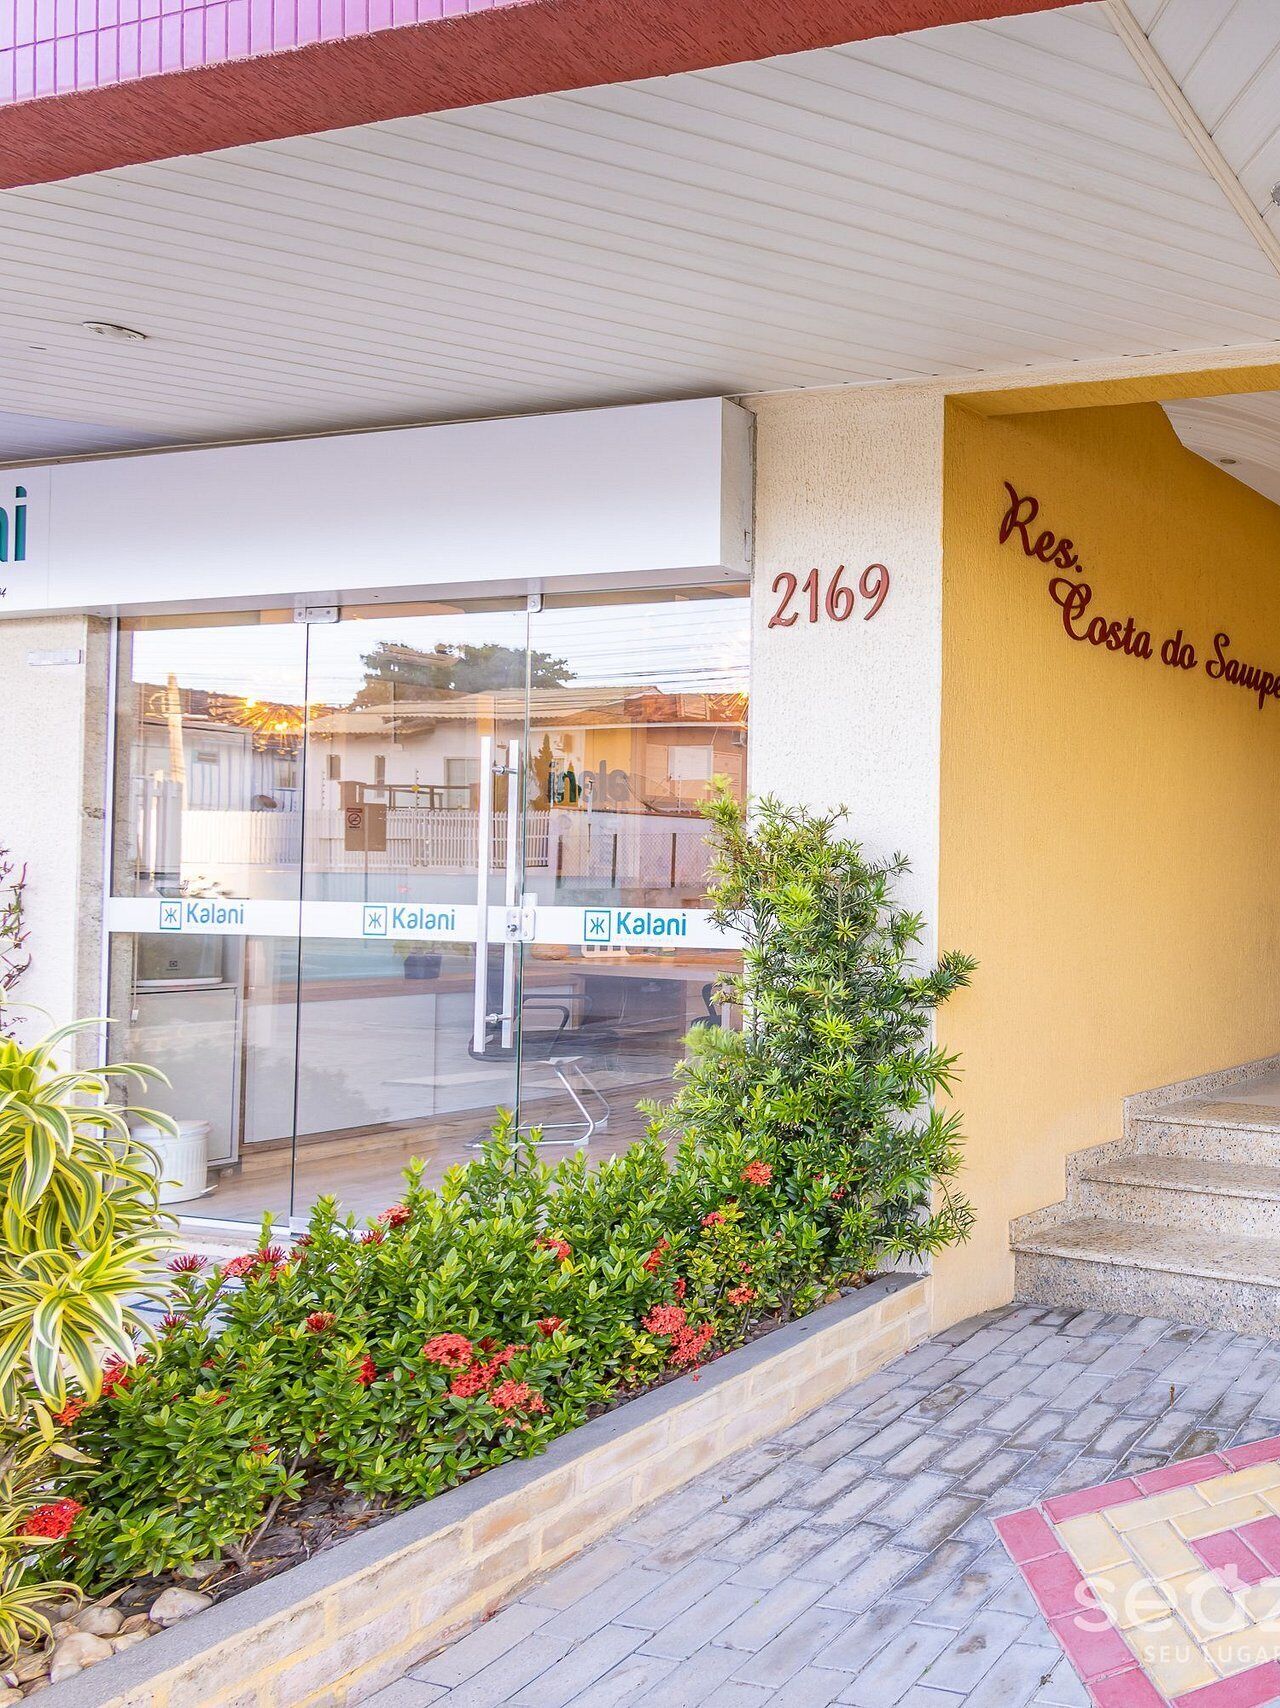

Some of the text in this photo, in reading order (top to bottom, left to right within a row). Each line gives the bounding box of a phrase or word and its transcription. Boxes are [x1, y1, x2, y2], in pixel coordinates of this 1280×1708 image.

[999, 481, 1083, 573] Res.
[767, 563, 890, 629] 2169
[1048, 577, 1153, 660] Costa
[1161, 629, 1198, 670] do
[186, 902, 244, 925] Kalani
[392, 907, 456, 931] Kalani
[616, 911, 687, 936] Kalani
